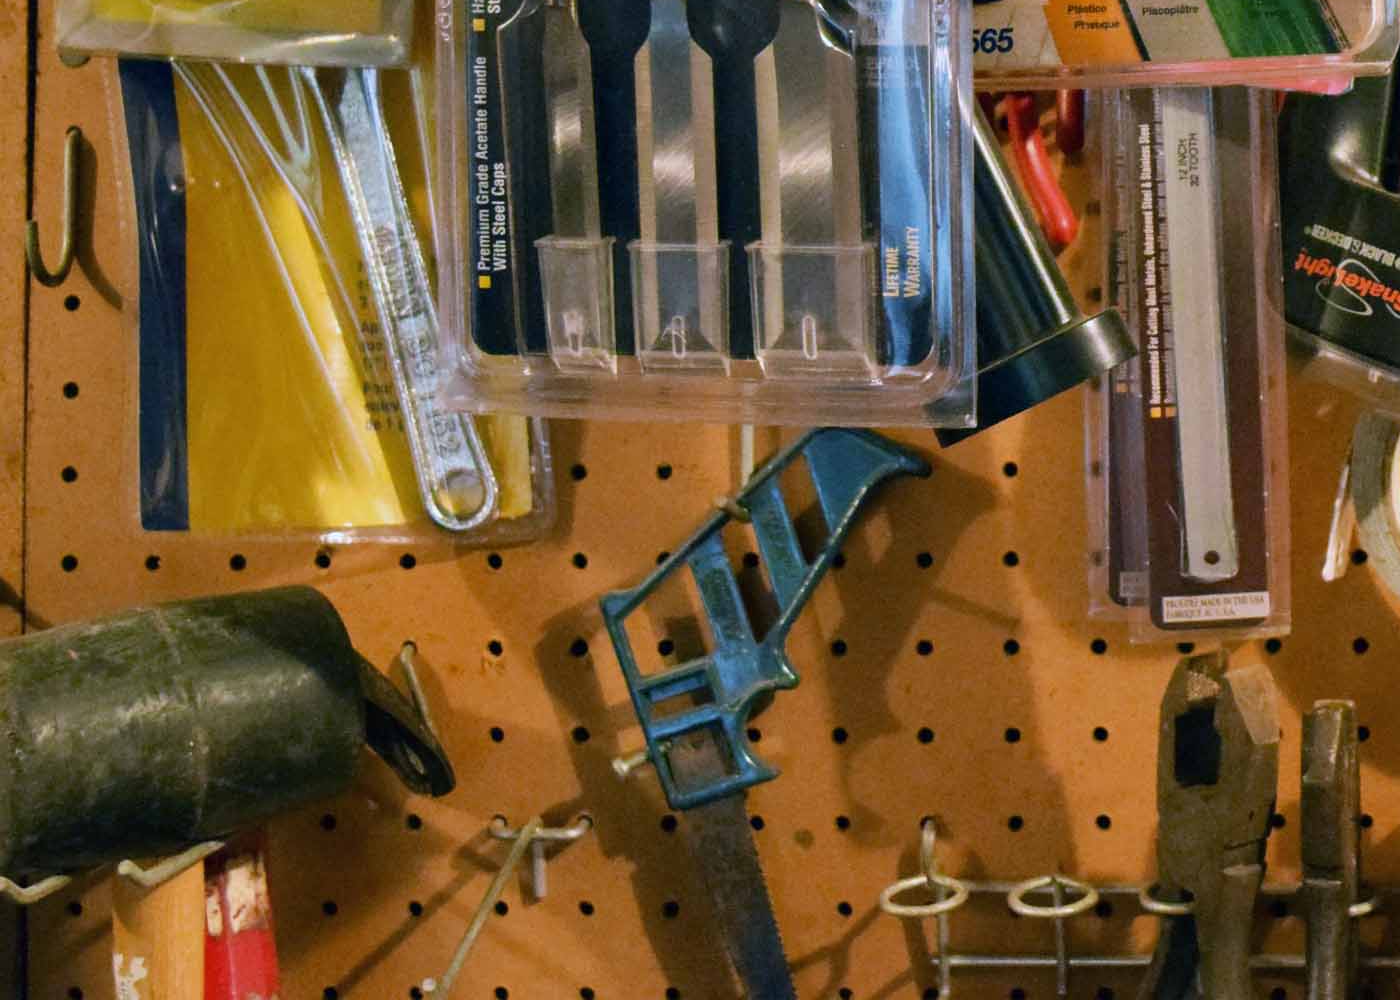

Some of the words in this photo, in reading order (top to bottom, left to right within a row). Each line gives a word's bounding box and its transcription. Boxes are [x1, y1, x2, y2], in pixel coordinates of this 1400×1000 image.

[473, 56, 487, 105] Handle
[474, 108, 488, 160] Acetate
[1189, 133, 1199, 172] TOOTH
[477, 164, 489, 205] Grade
[492, 162, 505, 195] Caps
[478, 209, 491, 271] Premium
[492, 203, 506, 235] Steel
[493, 241, 507, 271] With
[883, 247, 899, 297] LIFETIME
[904, 226, 920, 298] WARRANTY
